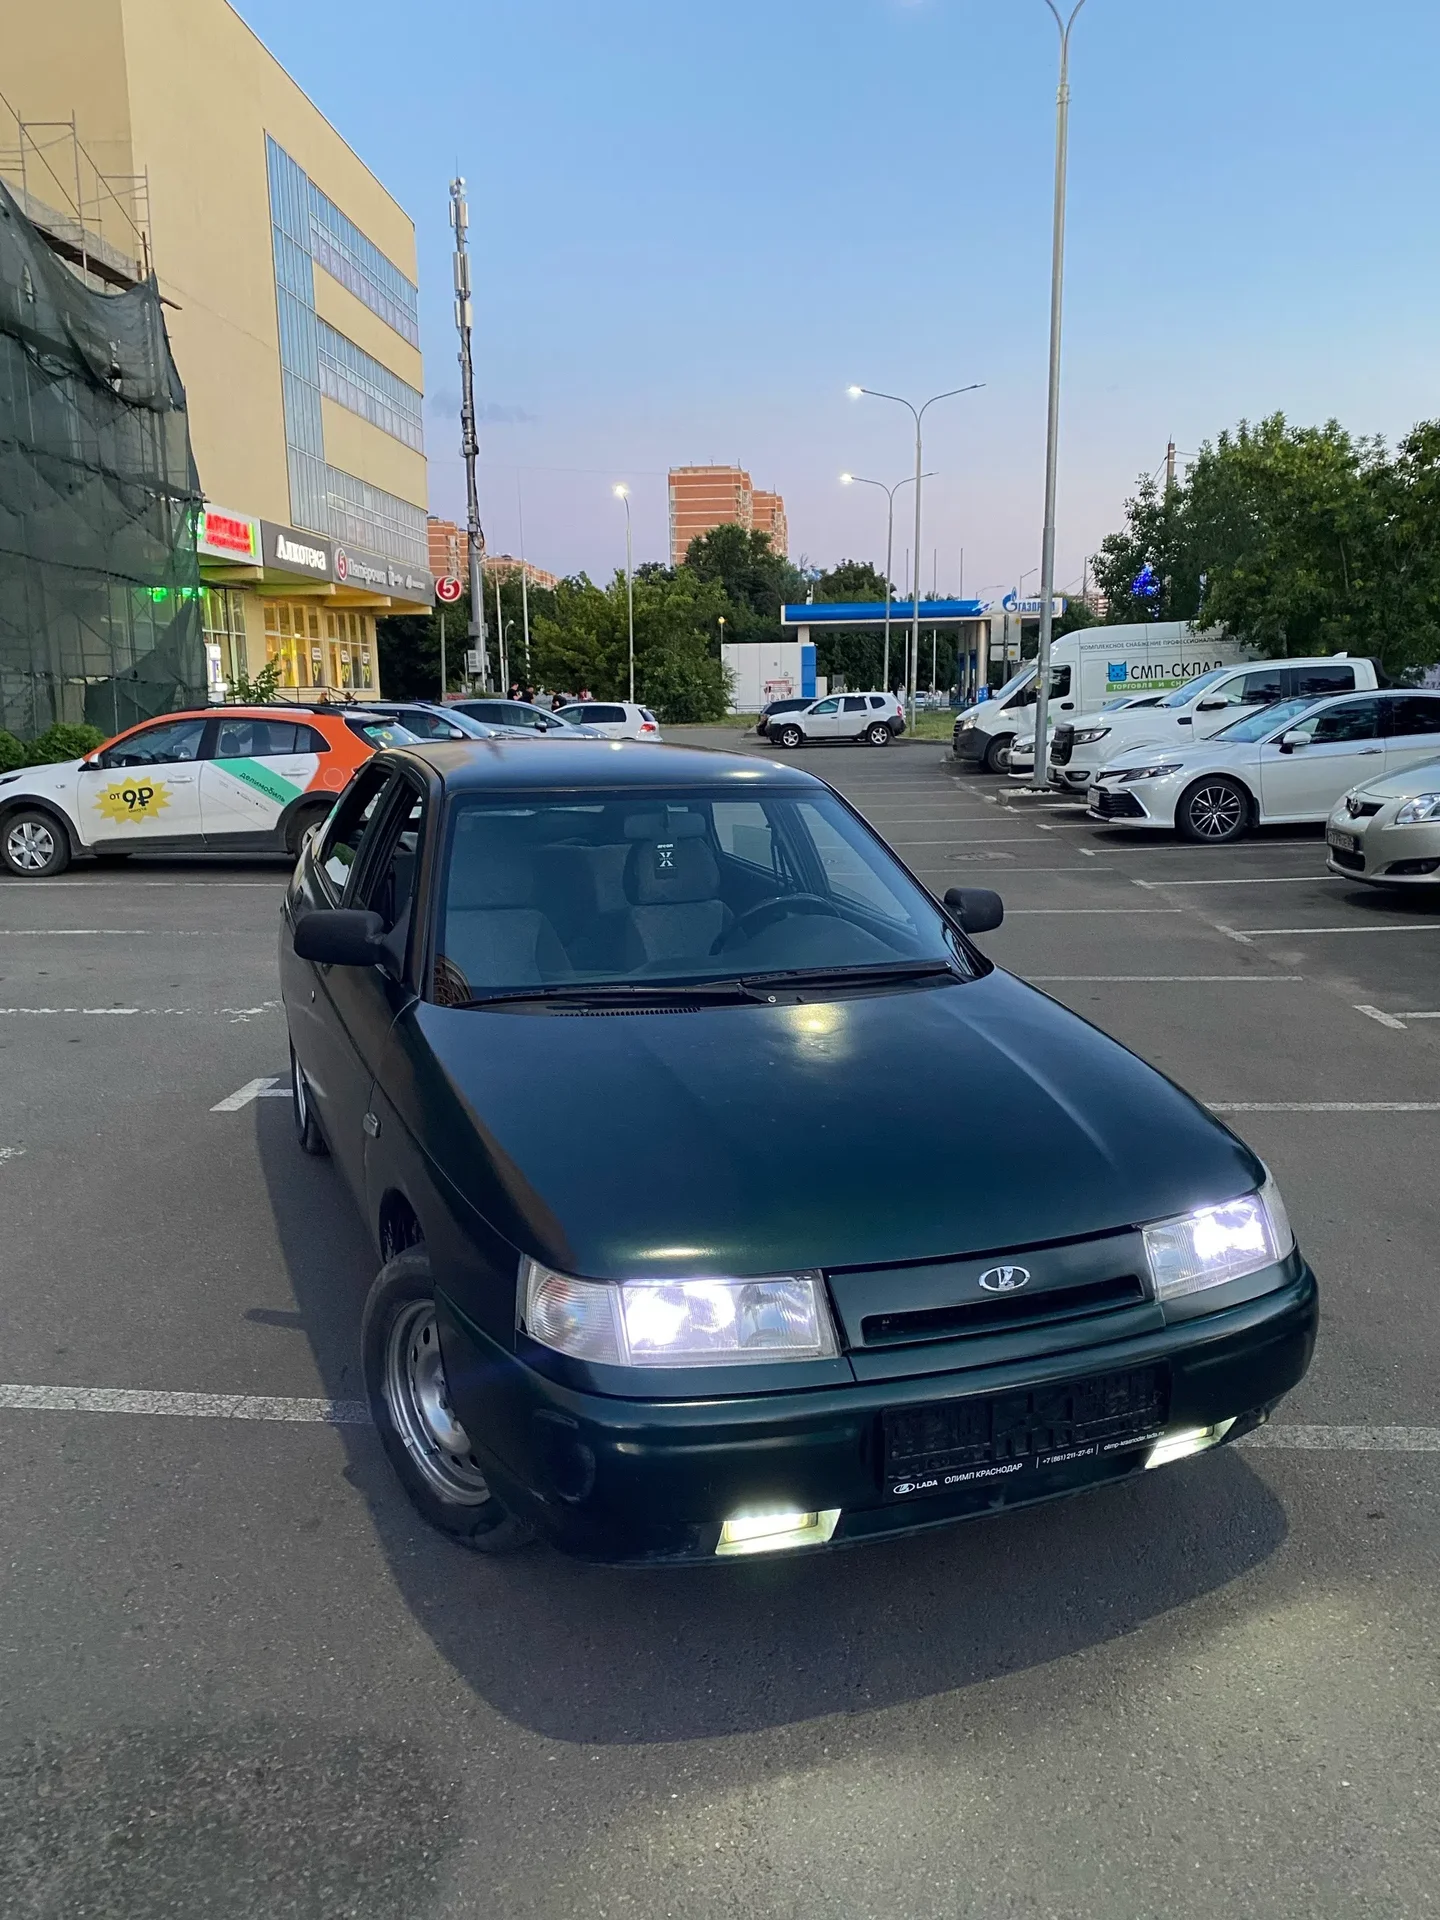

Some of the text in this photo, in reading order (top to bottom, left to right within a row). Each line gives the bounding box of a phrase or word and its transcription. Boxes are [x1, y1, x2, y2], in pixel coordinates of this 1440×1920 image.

[240, 772, 286, 803] делимобиль
[944, 1463, 1023, 1484] ОЛИМП КРАСНОДАР
[916, 1480, 938, 1489] LADA
